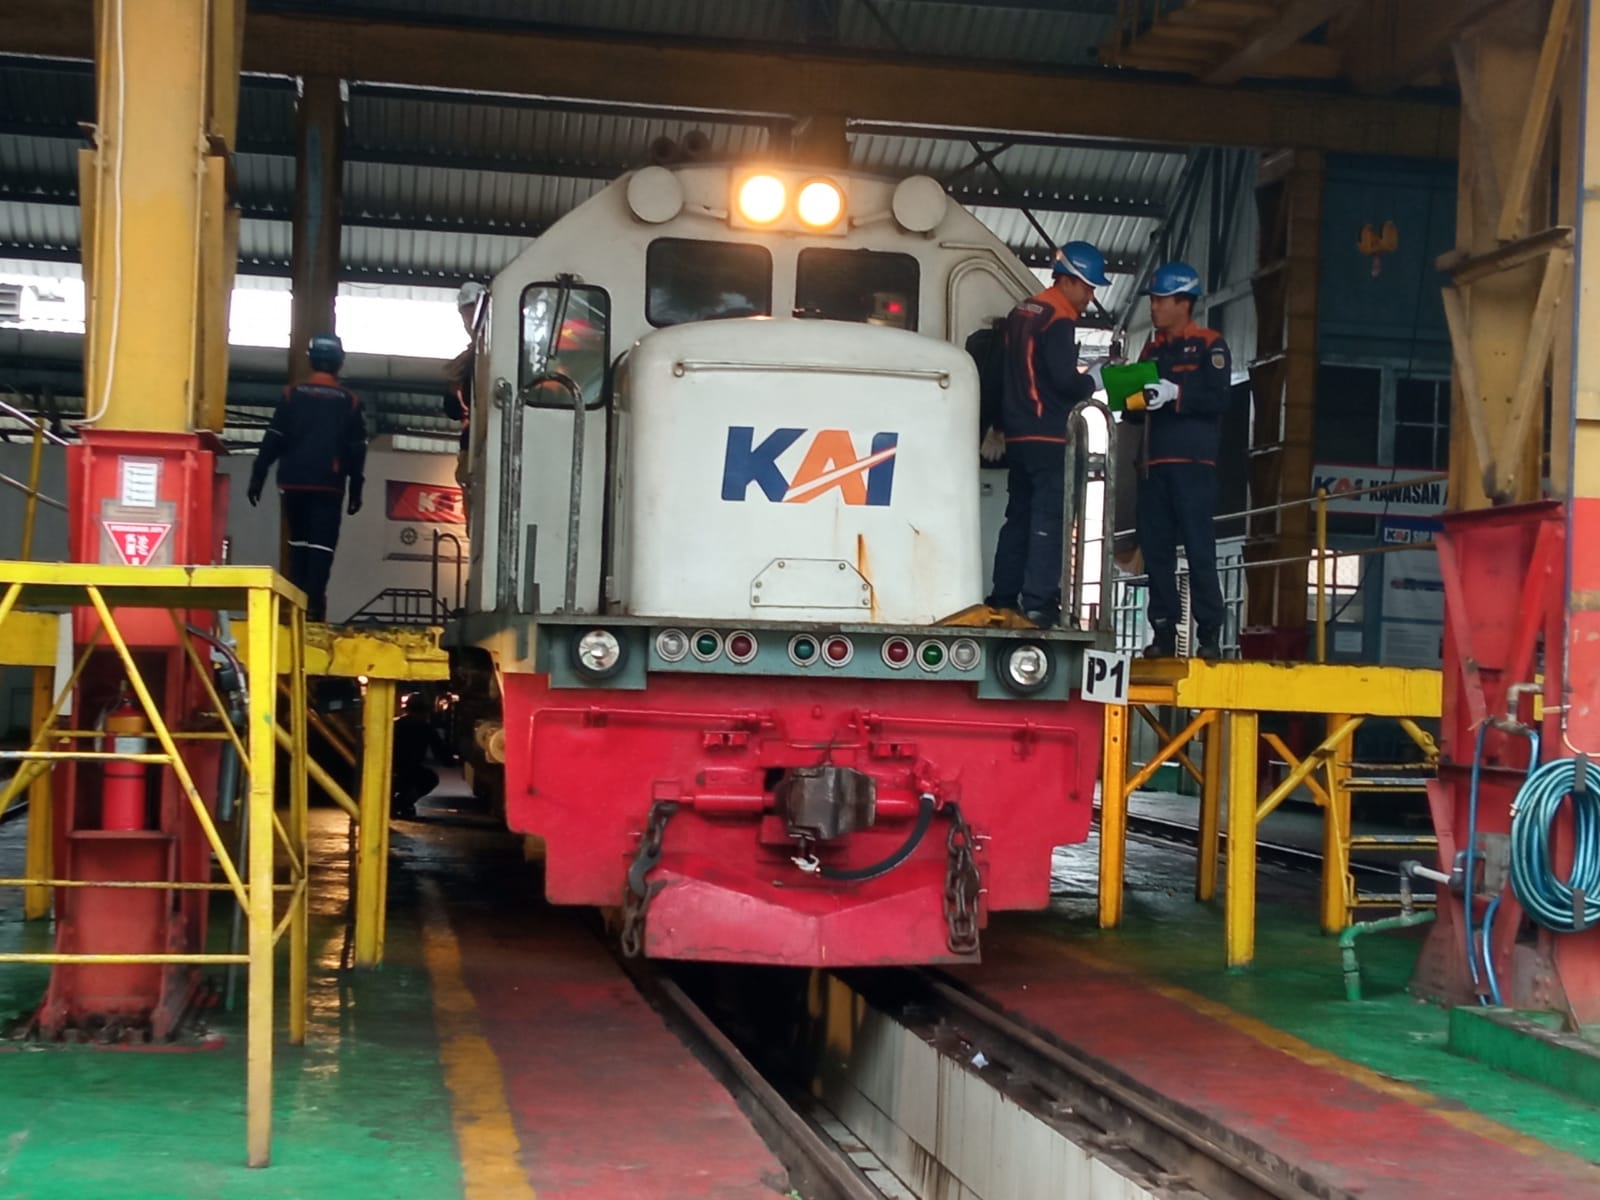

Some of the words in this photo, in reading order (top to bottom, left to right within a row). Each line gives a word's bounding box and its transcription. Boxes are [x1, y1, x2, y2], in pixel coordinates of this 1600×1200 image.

[721, 426, 899, 506] KAI
[1369, 480, 1440, 504] KAWASAN
[1086, 656, 1124, 698] P1
